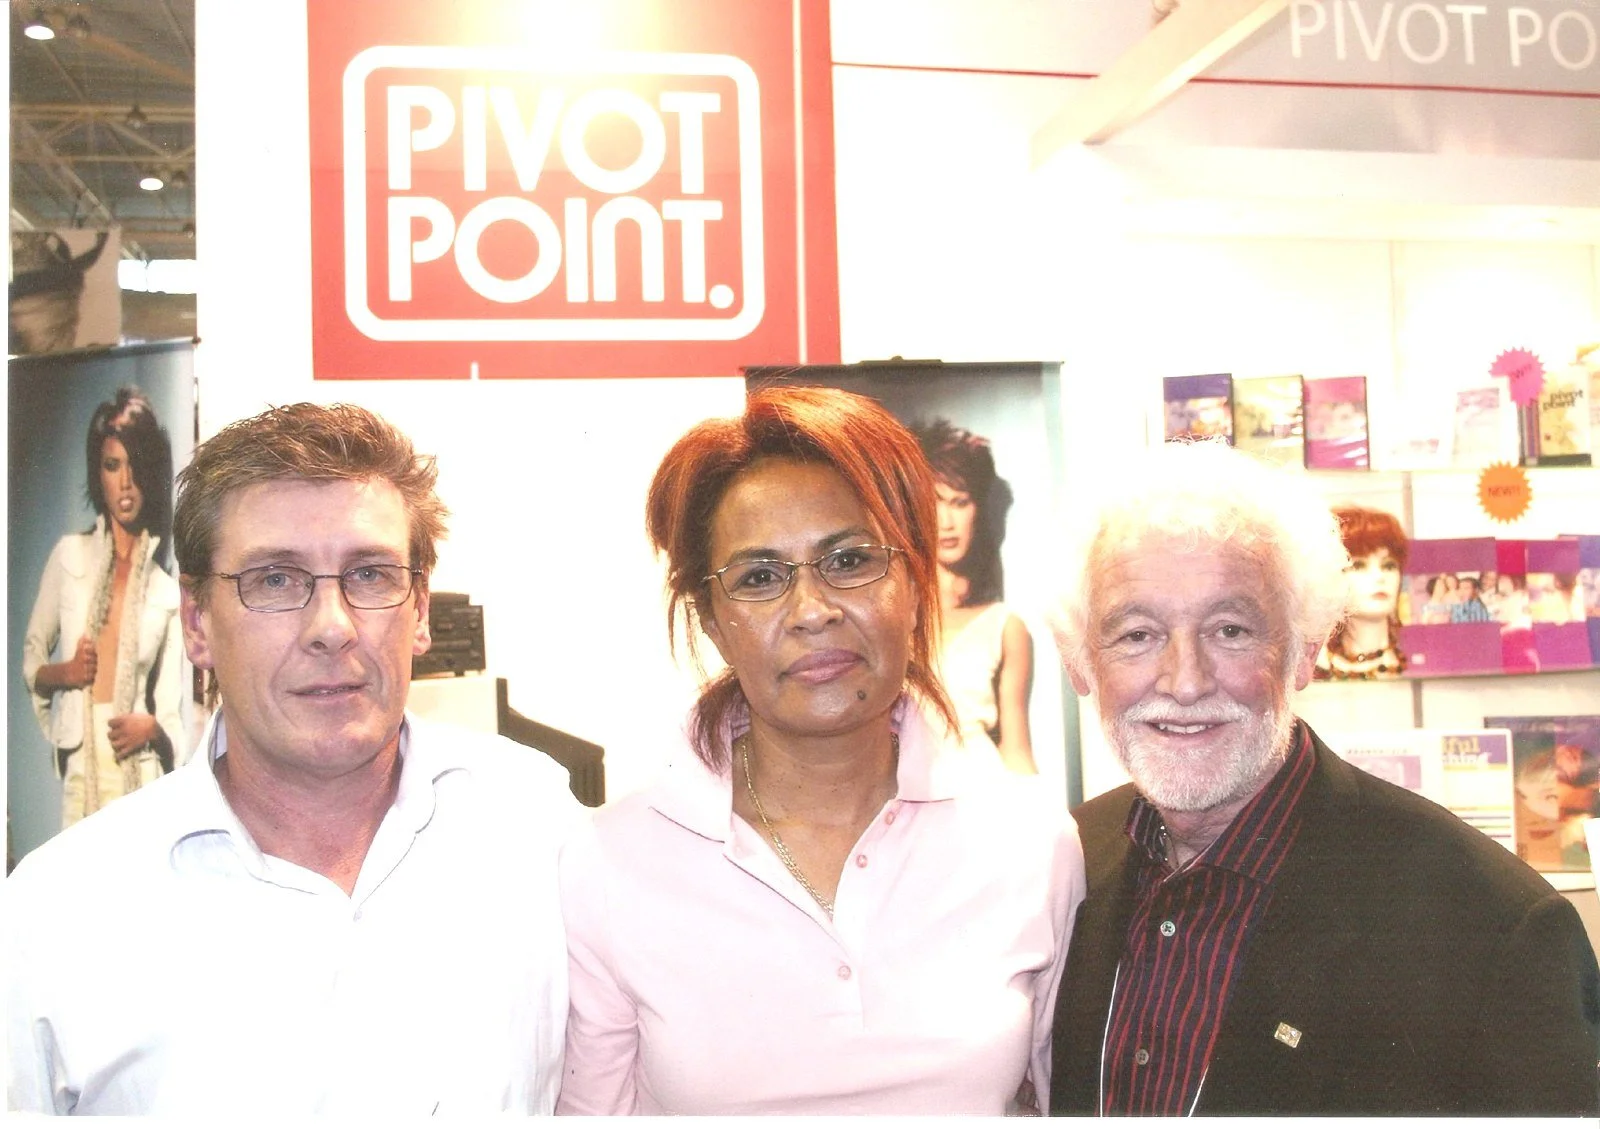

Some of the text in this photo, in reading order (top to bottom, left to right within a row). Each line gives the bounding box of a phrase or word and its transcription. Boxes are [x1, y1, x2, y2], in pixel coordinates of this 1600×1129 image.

[1290, 0, 1597, 71] PIVOT PO
[387, 84, 722, 195] PIVOT
